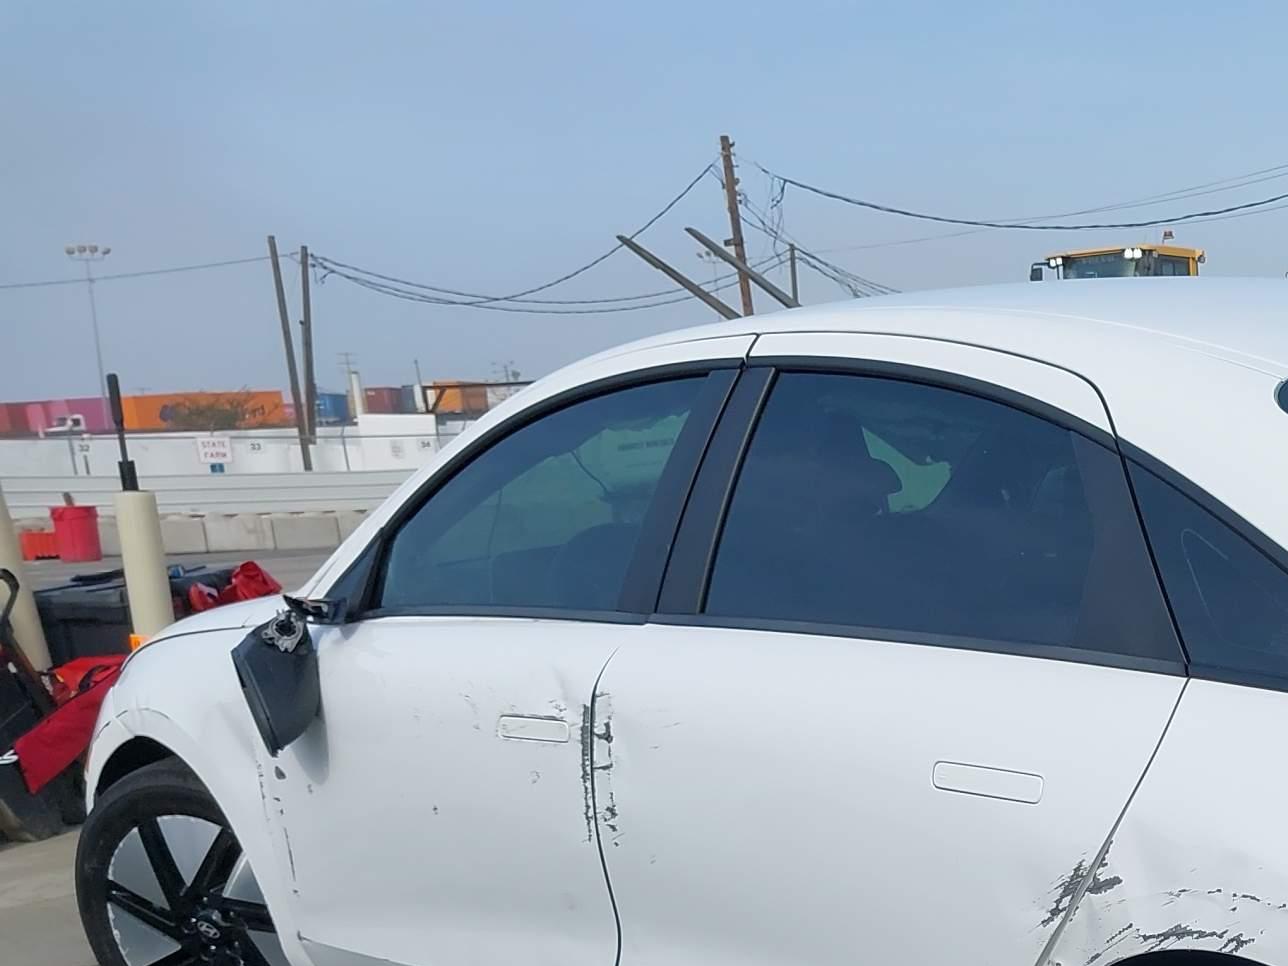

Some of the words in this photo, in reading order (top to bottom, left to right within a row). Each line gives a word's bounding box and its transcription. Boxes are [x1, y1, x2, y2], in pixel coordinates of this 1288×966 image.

[78, 443, 90, 452] 32
[200, 441, 226, 449] STATE
[249, 443, 262, 451] 33
